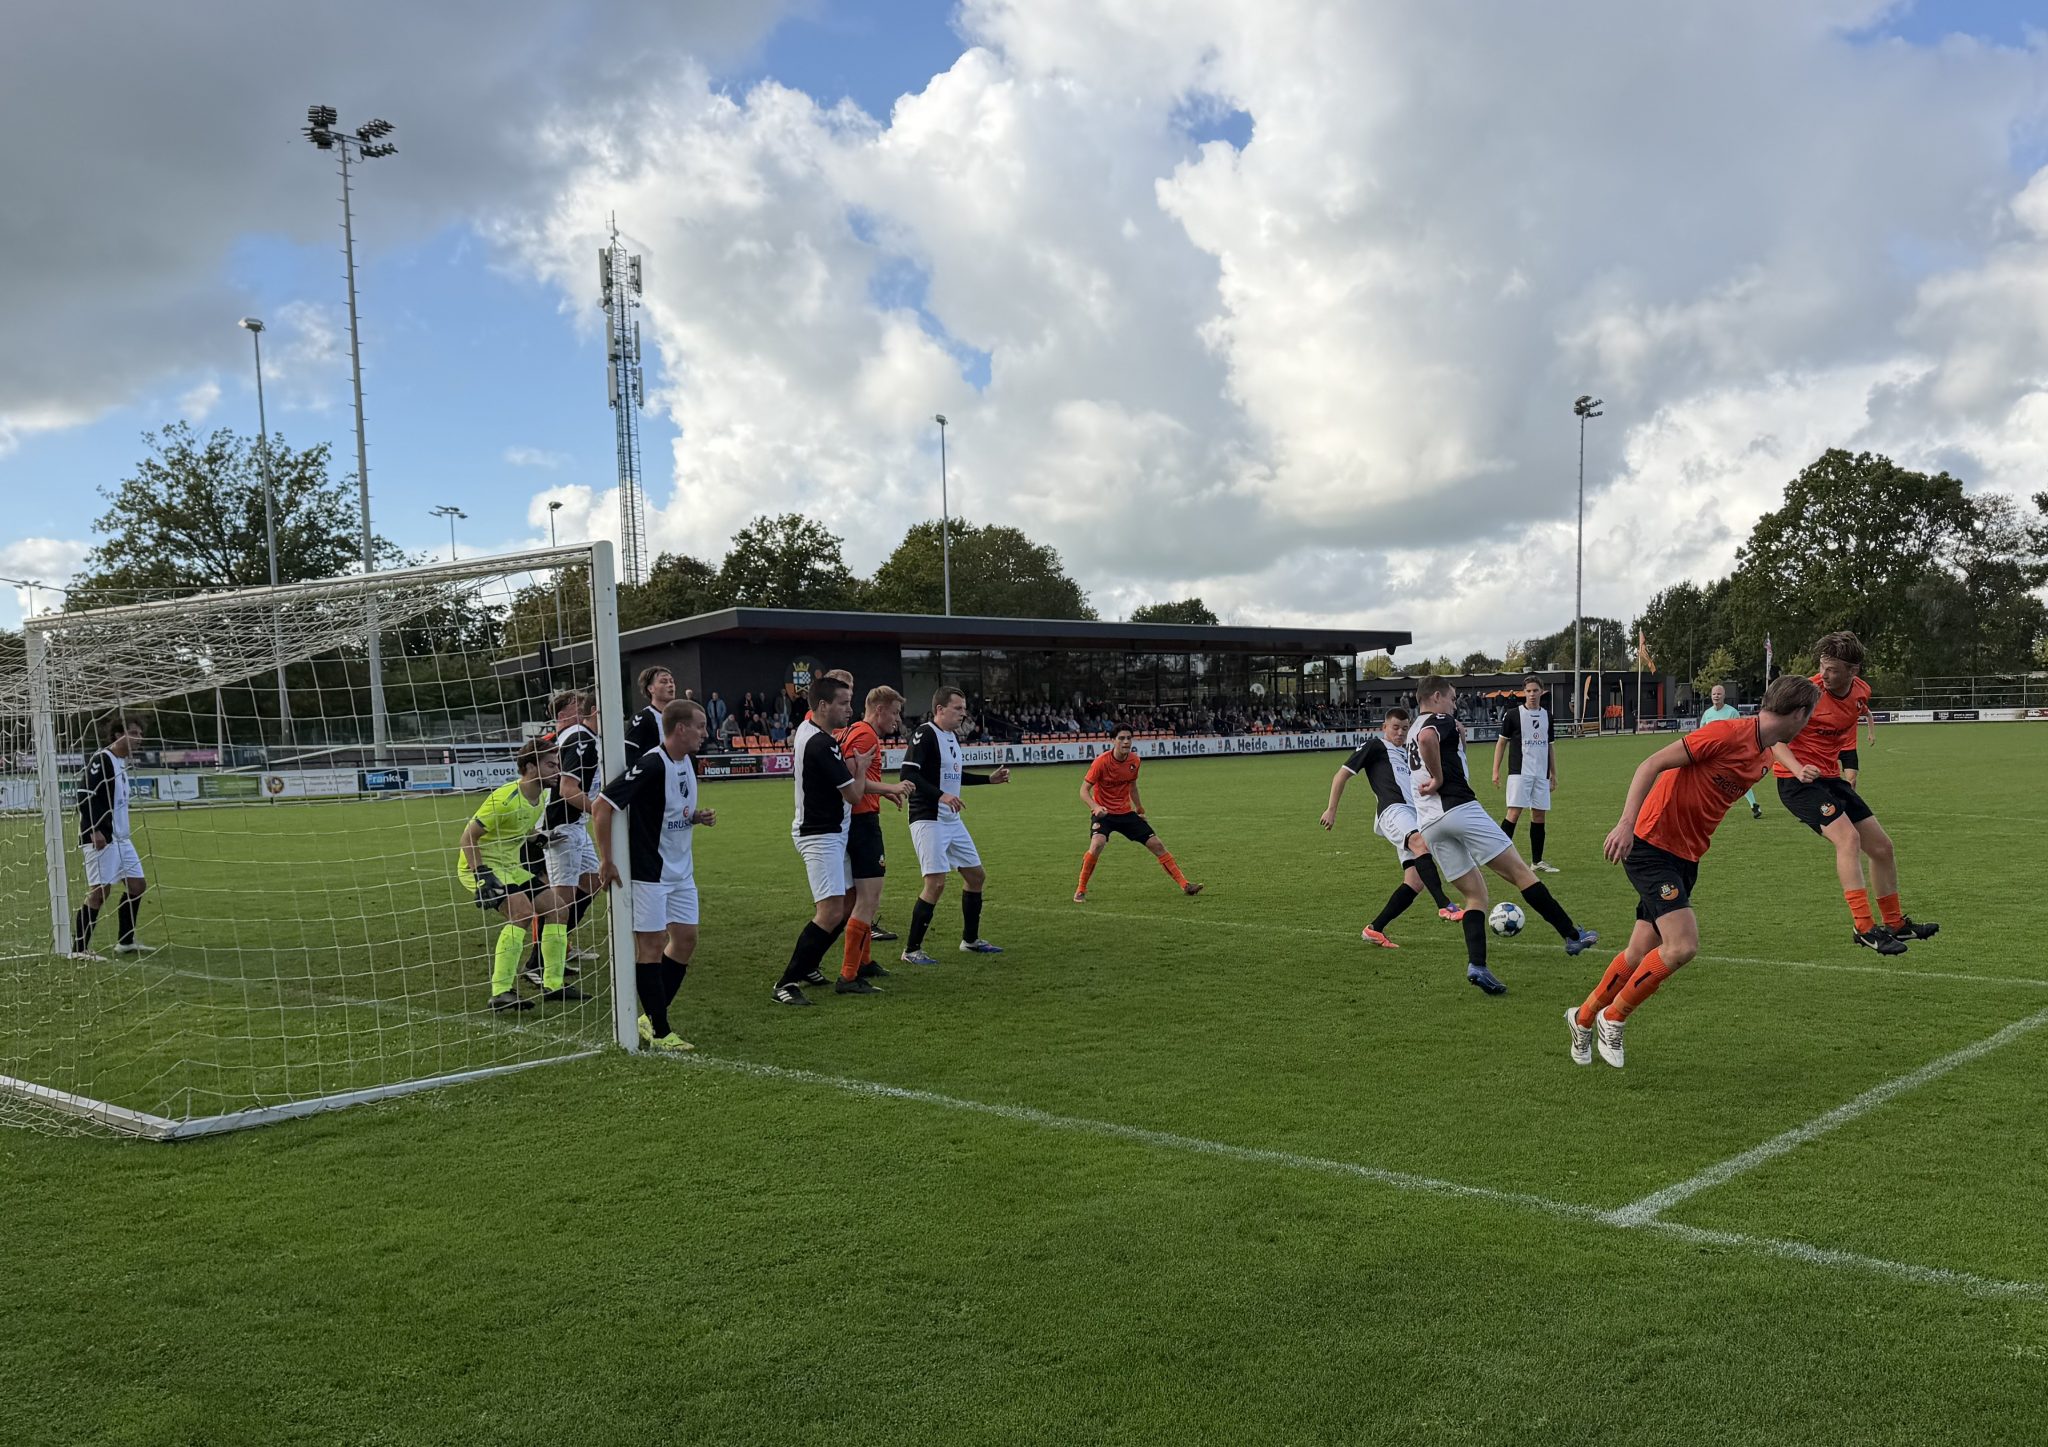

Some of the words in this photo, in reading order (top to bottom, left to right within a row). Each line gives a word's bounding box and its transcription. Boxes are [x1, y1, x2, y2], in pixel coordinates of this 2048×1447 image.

[1173, 740, 1206, 755] Heide
[1238, 738, 1268, 751] Heide
[1298, 735, 1325, 748] Heide
[961, 748, 992, 762] ecialist
[1023, 746, 1064, 761] Heide
[463, 769, 483, 777] van
